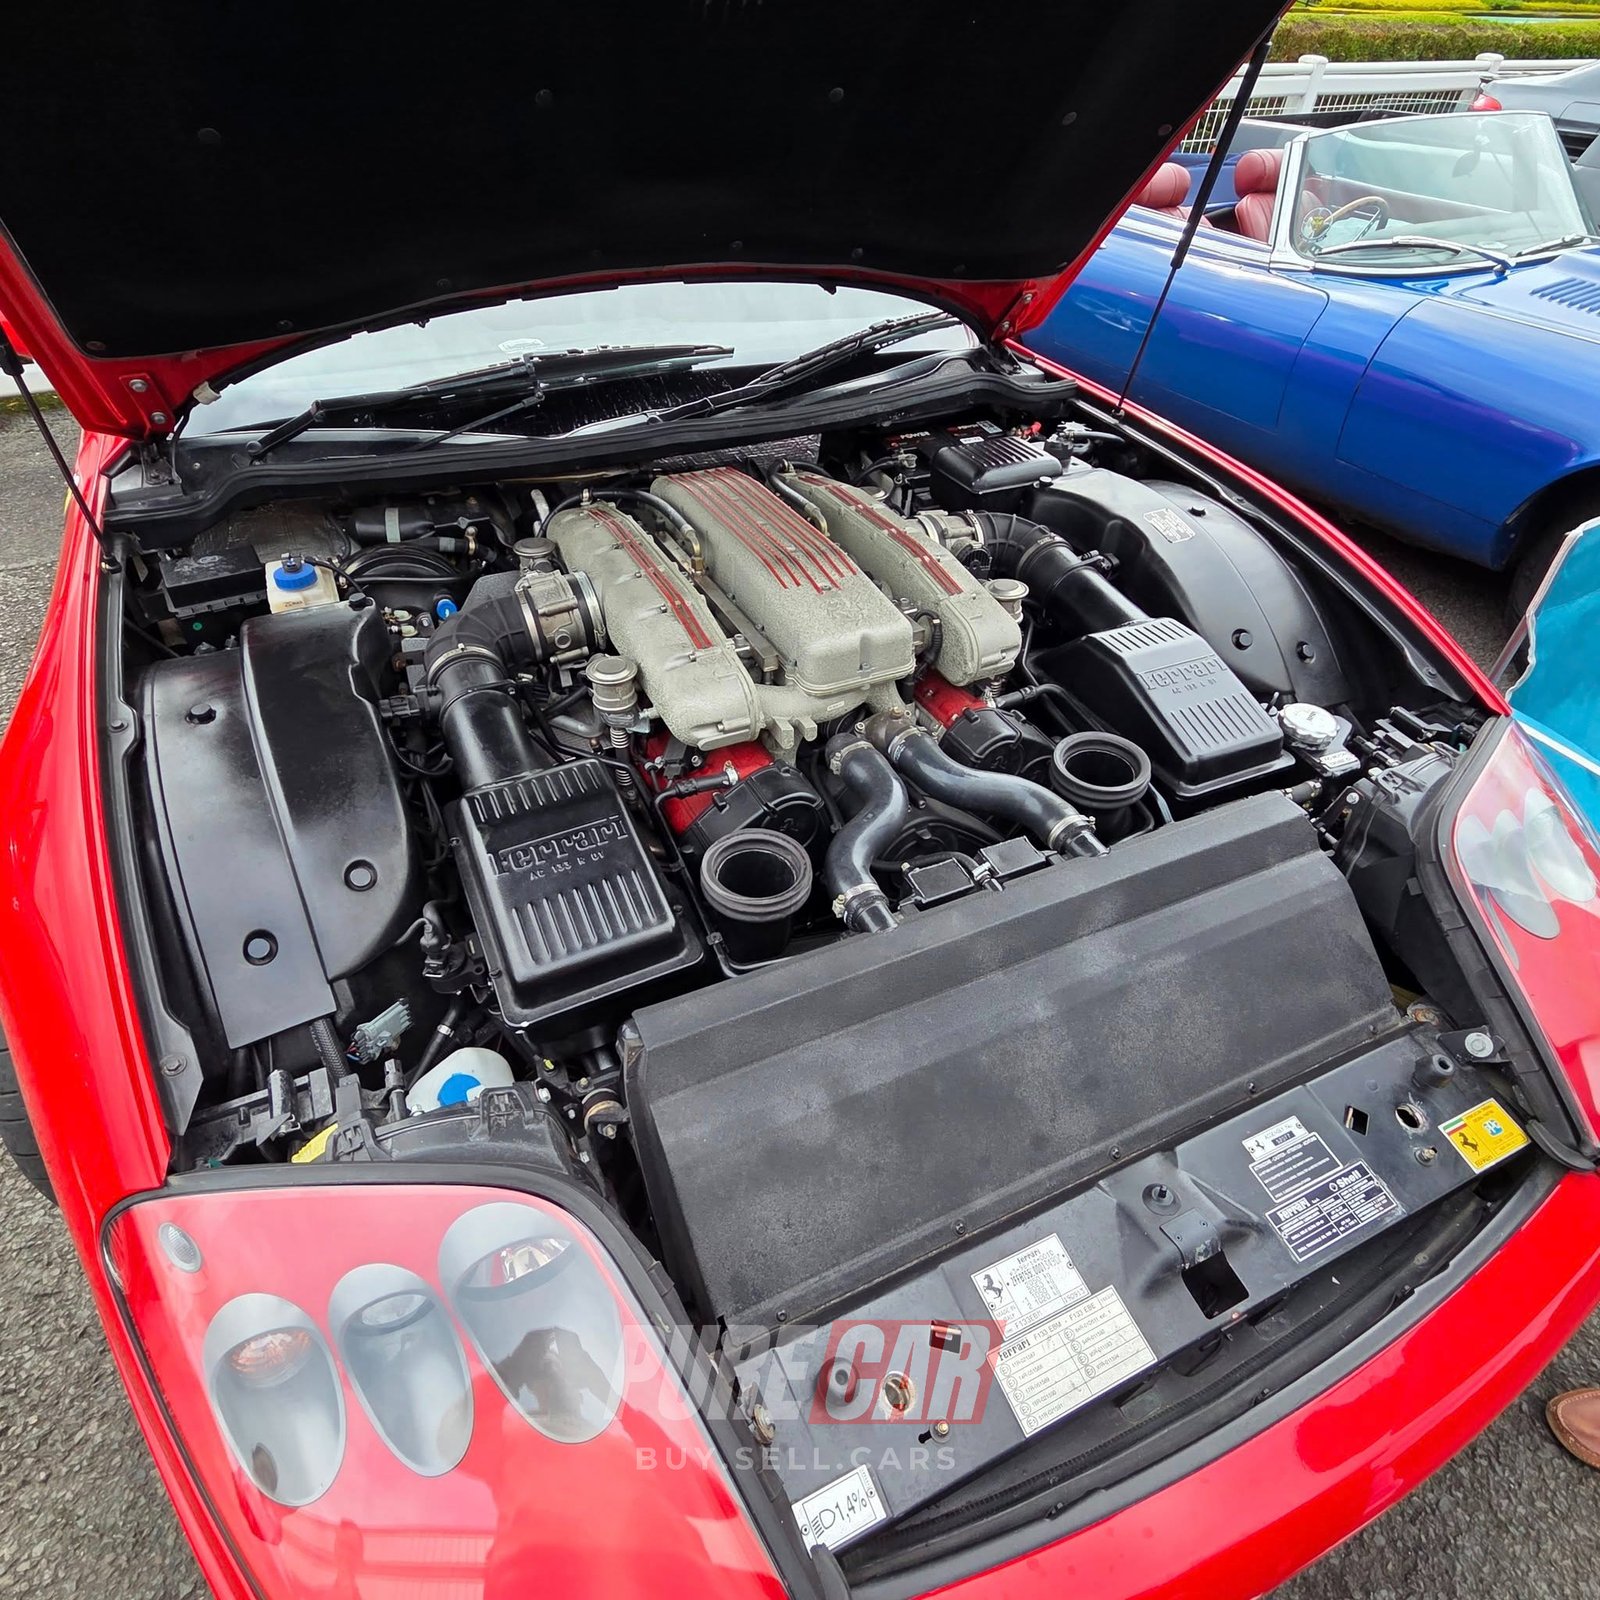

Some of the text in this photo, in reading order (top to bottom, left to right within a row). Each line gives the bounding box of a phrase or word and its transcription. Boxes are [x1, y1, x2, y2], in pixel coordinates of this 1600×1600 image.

[1136, 654, 1227, 691] Ferrari
[486, 815, 628, 877] Ferrari
[1334, 1168, 1362, 1188] Shell
[1276, 1196, 1311, 1221] Ferrari
[996, 1336, 1031, 1361] Ferrari
[1033, 1328, 1048, 1340] F133
[1047, 1320, 1062, 1332] EBM
[1068, 1308, 1083, 1321] F133
[1083, 1301, 1096, 1313] EBE
[835, 1489, 867, 1523] 1,4%
